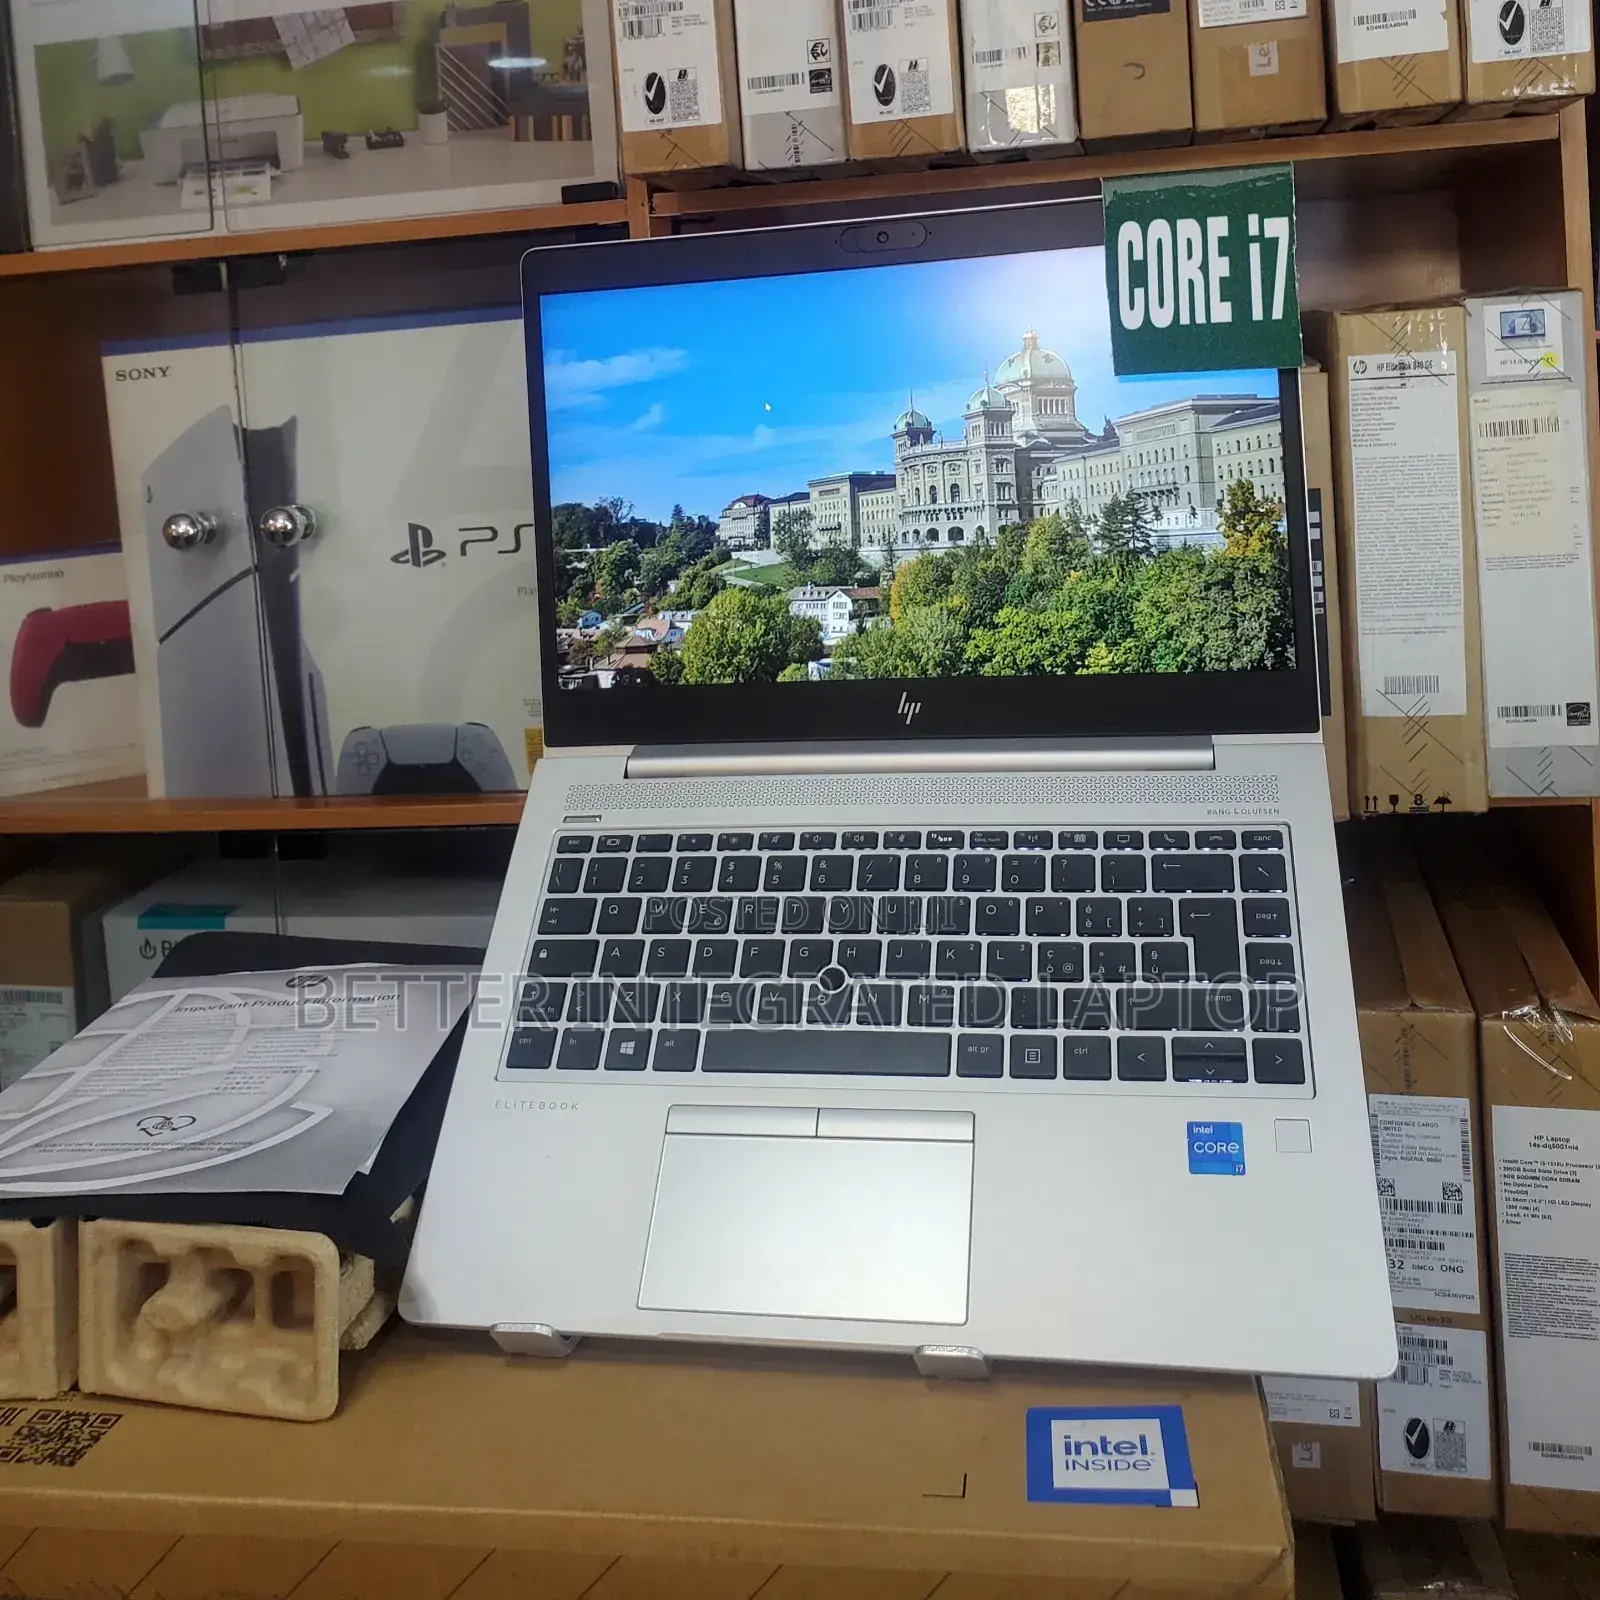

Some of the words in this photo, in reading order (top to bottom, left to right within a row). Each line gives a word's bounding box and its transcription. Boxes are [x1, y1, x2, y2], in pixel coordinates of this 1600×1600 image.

[1117, 216, 1233, 330] CORE
[1247, 213, 1290, 322] i7
[115, 365, 171, 383] SONY
[728, 861, 735, 871] $
[774, 861, 782, 870] %
[636, 876, 643, 885] 2
[681, 876, 688, 884] 3
[726, 875, 733, 884] 4
[772, 875, 780, 884] 5
[818, 875, 826, 883] 6
[865, 875, 873, 883] 7
[914, 875, 921, 883] 8
[962, 875, 970, 883] 9
[608, 905, 619, 915] Q
[654, 904, 668, 914] W
[699, 904, 707, 914] E
[745, 904, 754, 914] R
[791, 904, 800, 913] T
[840, 904, 849, 913] Y
[887, 904, 897, 914] U
[1035, 906, 1043, 915] P
[611, 947, 621, 957] A
[657, 947, 665, 957] S
[703, 947, 713, 957] D
[750, 947, 759, 956] F
[799, 947, 809, 957] G
[846, 947, 856, 957] H
[896, 948, 903, 958] J
[946, 949, 955, 959] K
[996, 950, 1004, 960] L
[672, 992, 682, 1001] X
[769, 992, 780, 1001] V
[868, 993, 878, 1003] N
[919, 994, 929, 1004] M
[174, 1001, 249, 1013] Important
[569, 1038, 577, 1046] fn
[1074, 1047, 1088, 1055] ctrl
[495, 1100, 579, 1111] ELITEBOOK
[1193, 1125, 1213, 1134] intel
[1440, 1265, 1464, 1273] ONG
